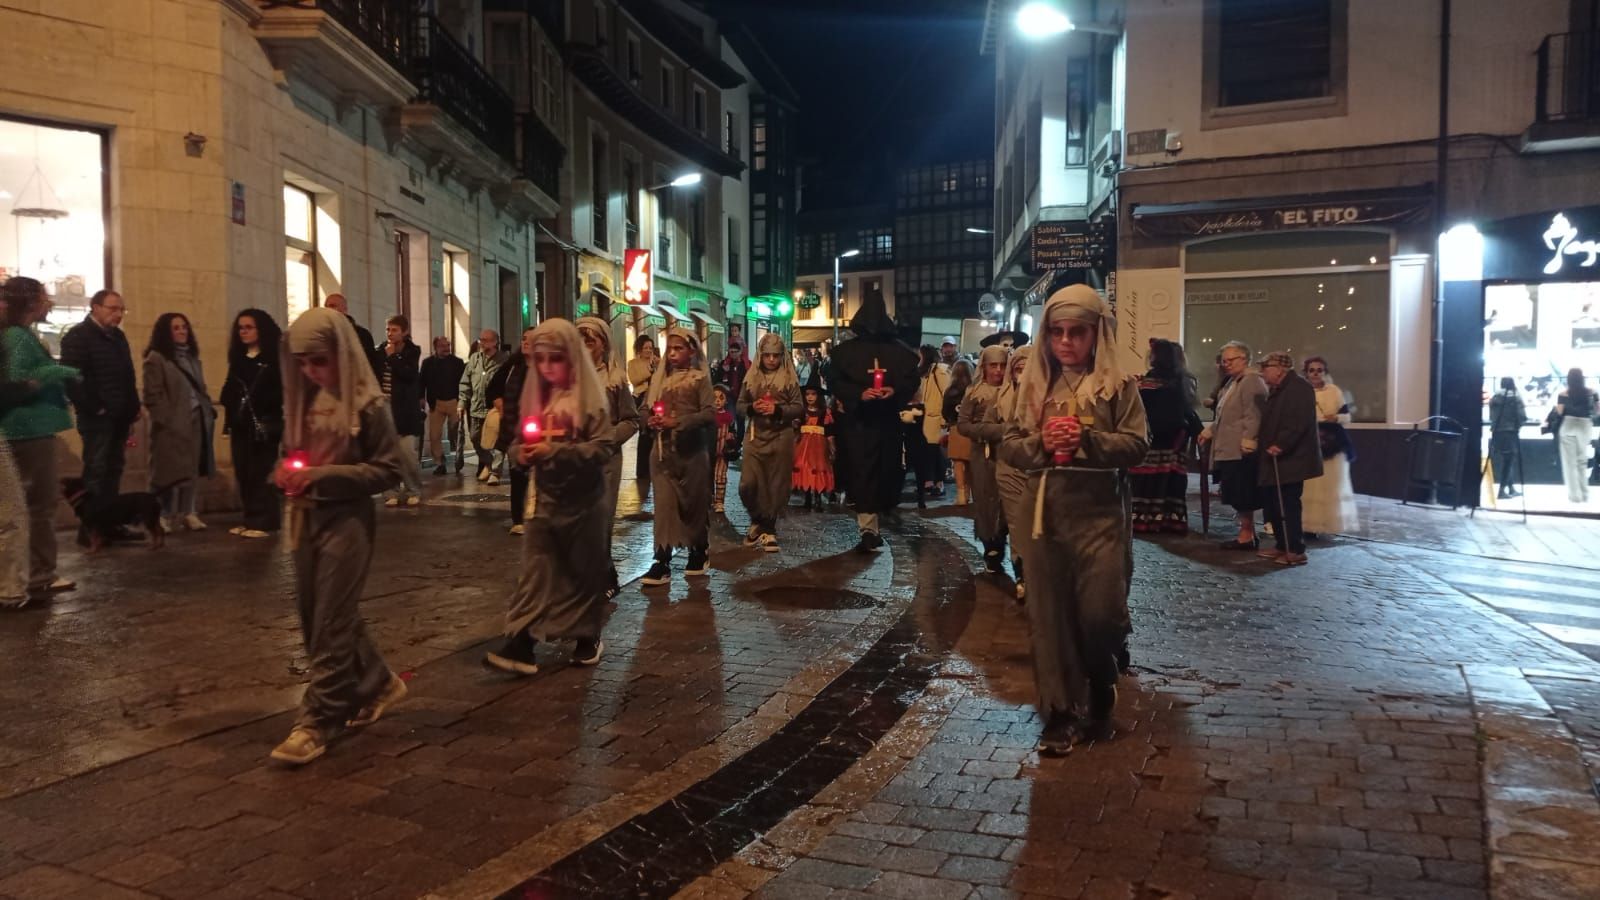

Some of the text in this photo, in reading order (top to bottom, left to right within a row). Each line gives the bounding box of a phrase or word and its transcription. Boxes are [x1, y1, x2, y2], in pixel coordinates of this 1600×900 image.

[1283, 210, 1307, 225] EL
[1312, 207, 1358, 223] FITO
[1036, 262, 1056, 270] Playa
[1068, 260, 1092, 268] Sablón
